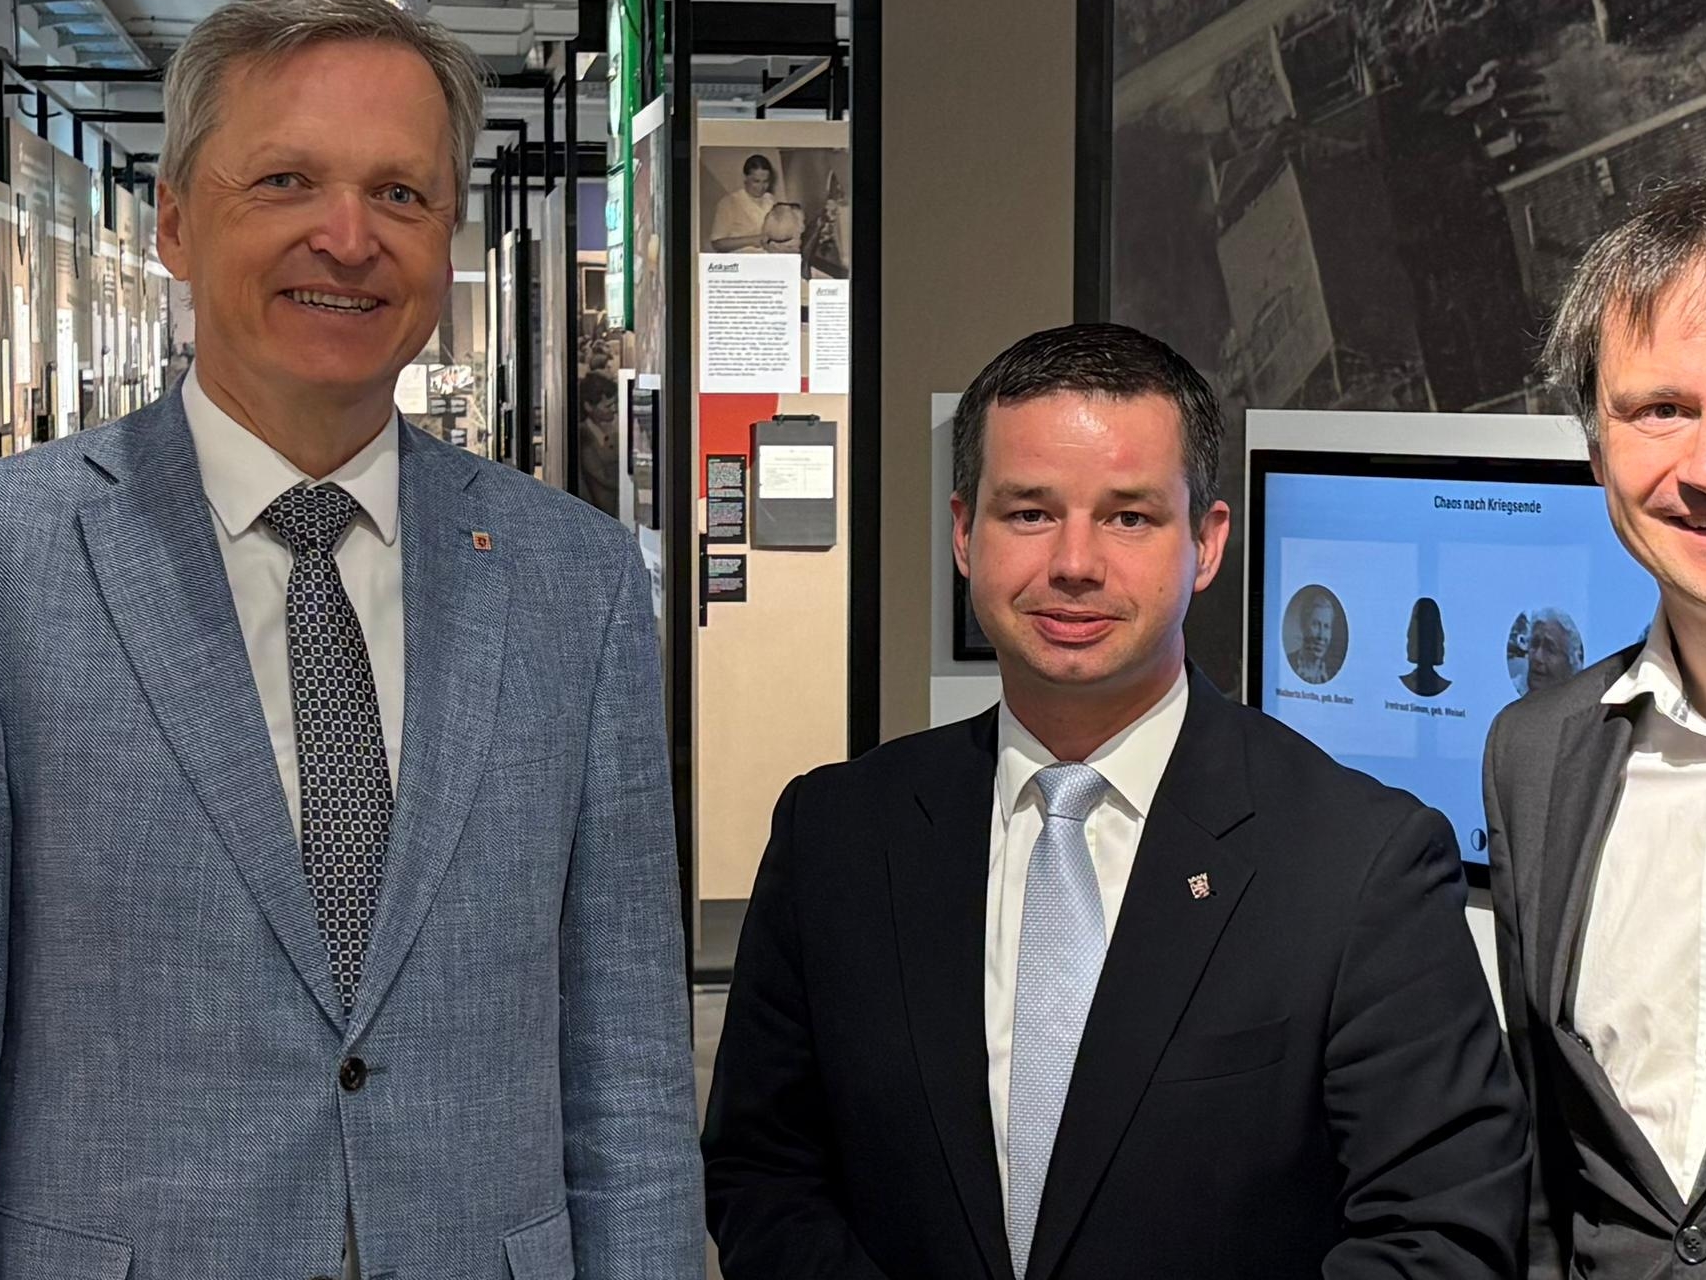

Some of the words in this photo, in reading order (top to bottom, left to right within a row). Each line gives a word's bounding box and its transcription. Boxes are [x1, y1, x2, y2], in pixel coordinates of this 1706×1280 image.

[1434, 495, 1462, 509] Chaos
[1464, 497, 1486, 511] nach
[1488, 498, 1542, 516] Kriegsende
